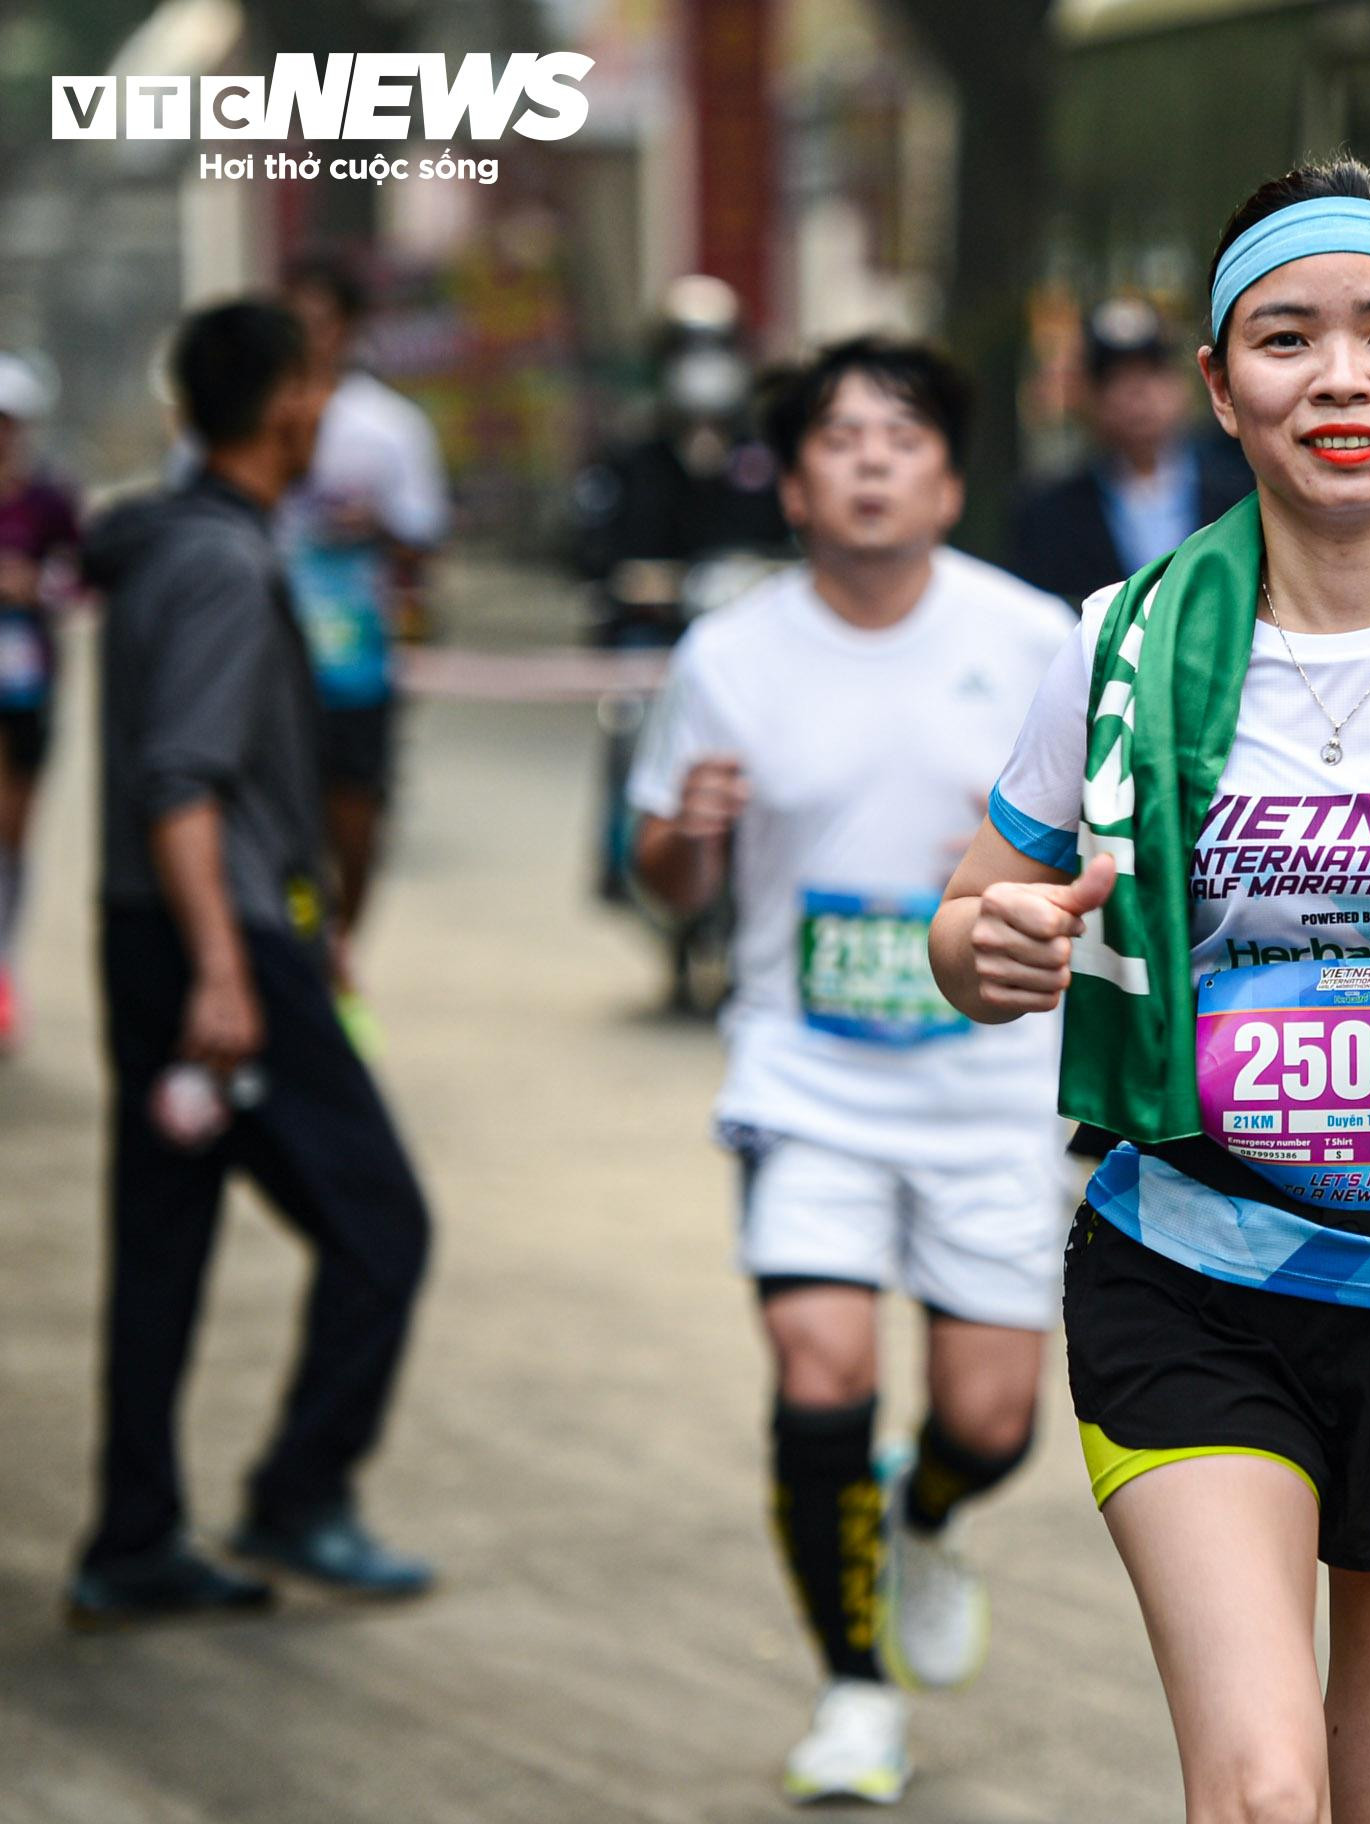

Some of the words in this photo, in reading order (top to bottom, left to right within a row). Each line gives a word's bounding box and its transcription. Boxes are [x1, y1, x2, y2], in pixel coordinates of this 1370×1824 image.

[1189, 877, 1241, 900] ALF
[1301, 913, 1359, 926] POWERED
[1233, 1115, 1274, 1129] 21KM
[1227, 1137, 1275, 1147] Emergency
[1276, 1138, 1311, 1147] number
[1332, 1138, 1353, 1146] Shirt
[1336, 1151, 1342, 1159] S
[1310, 1173, 1361, 1187] LET'S
